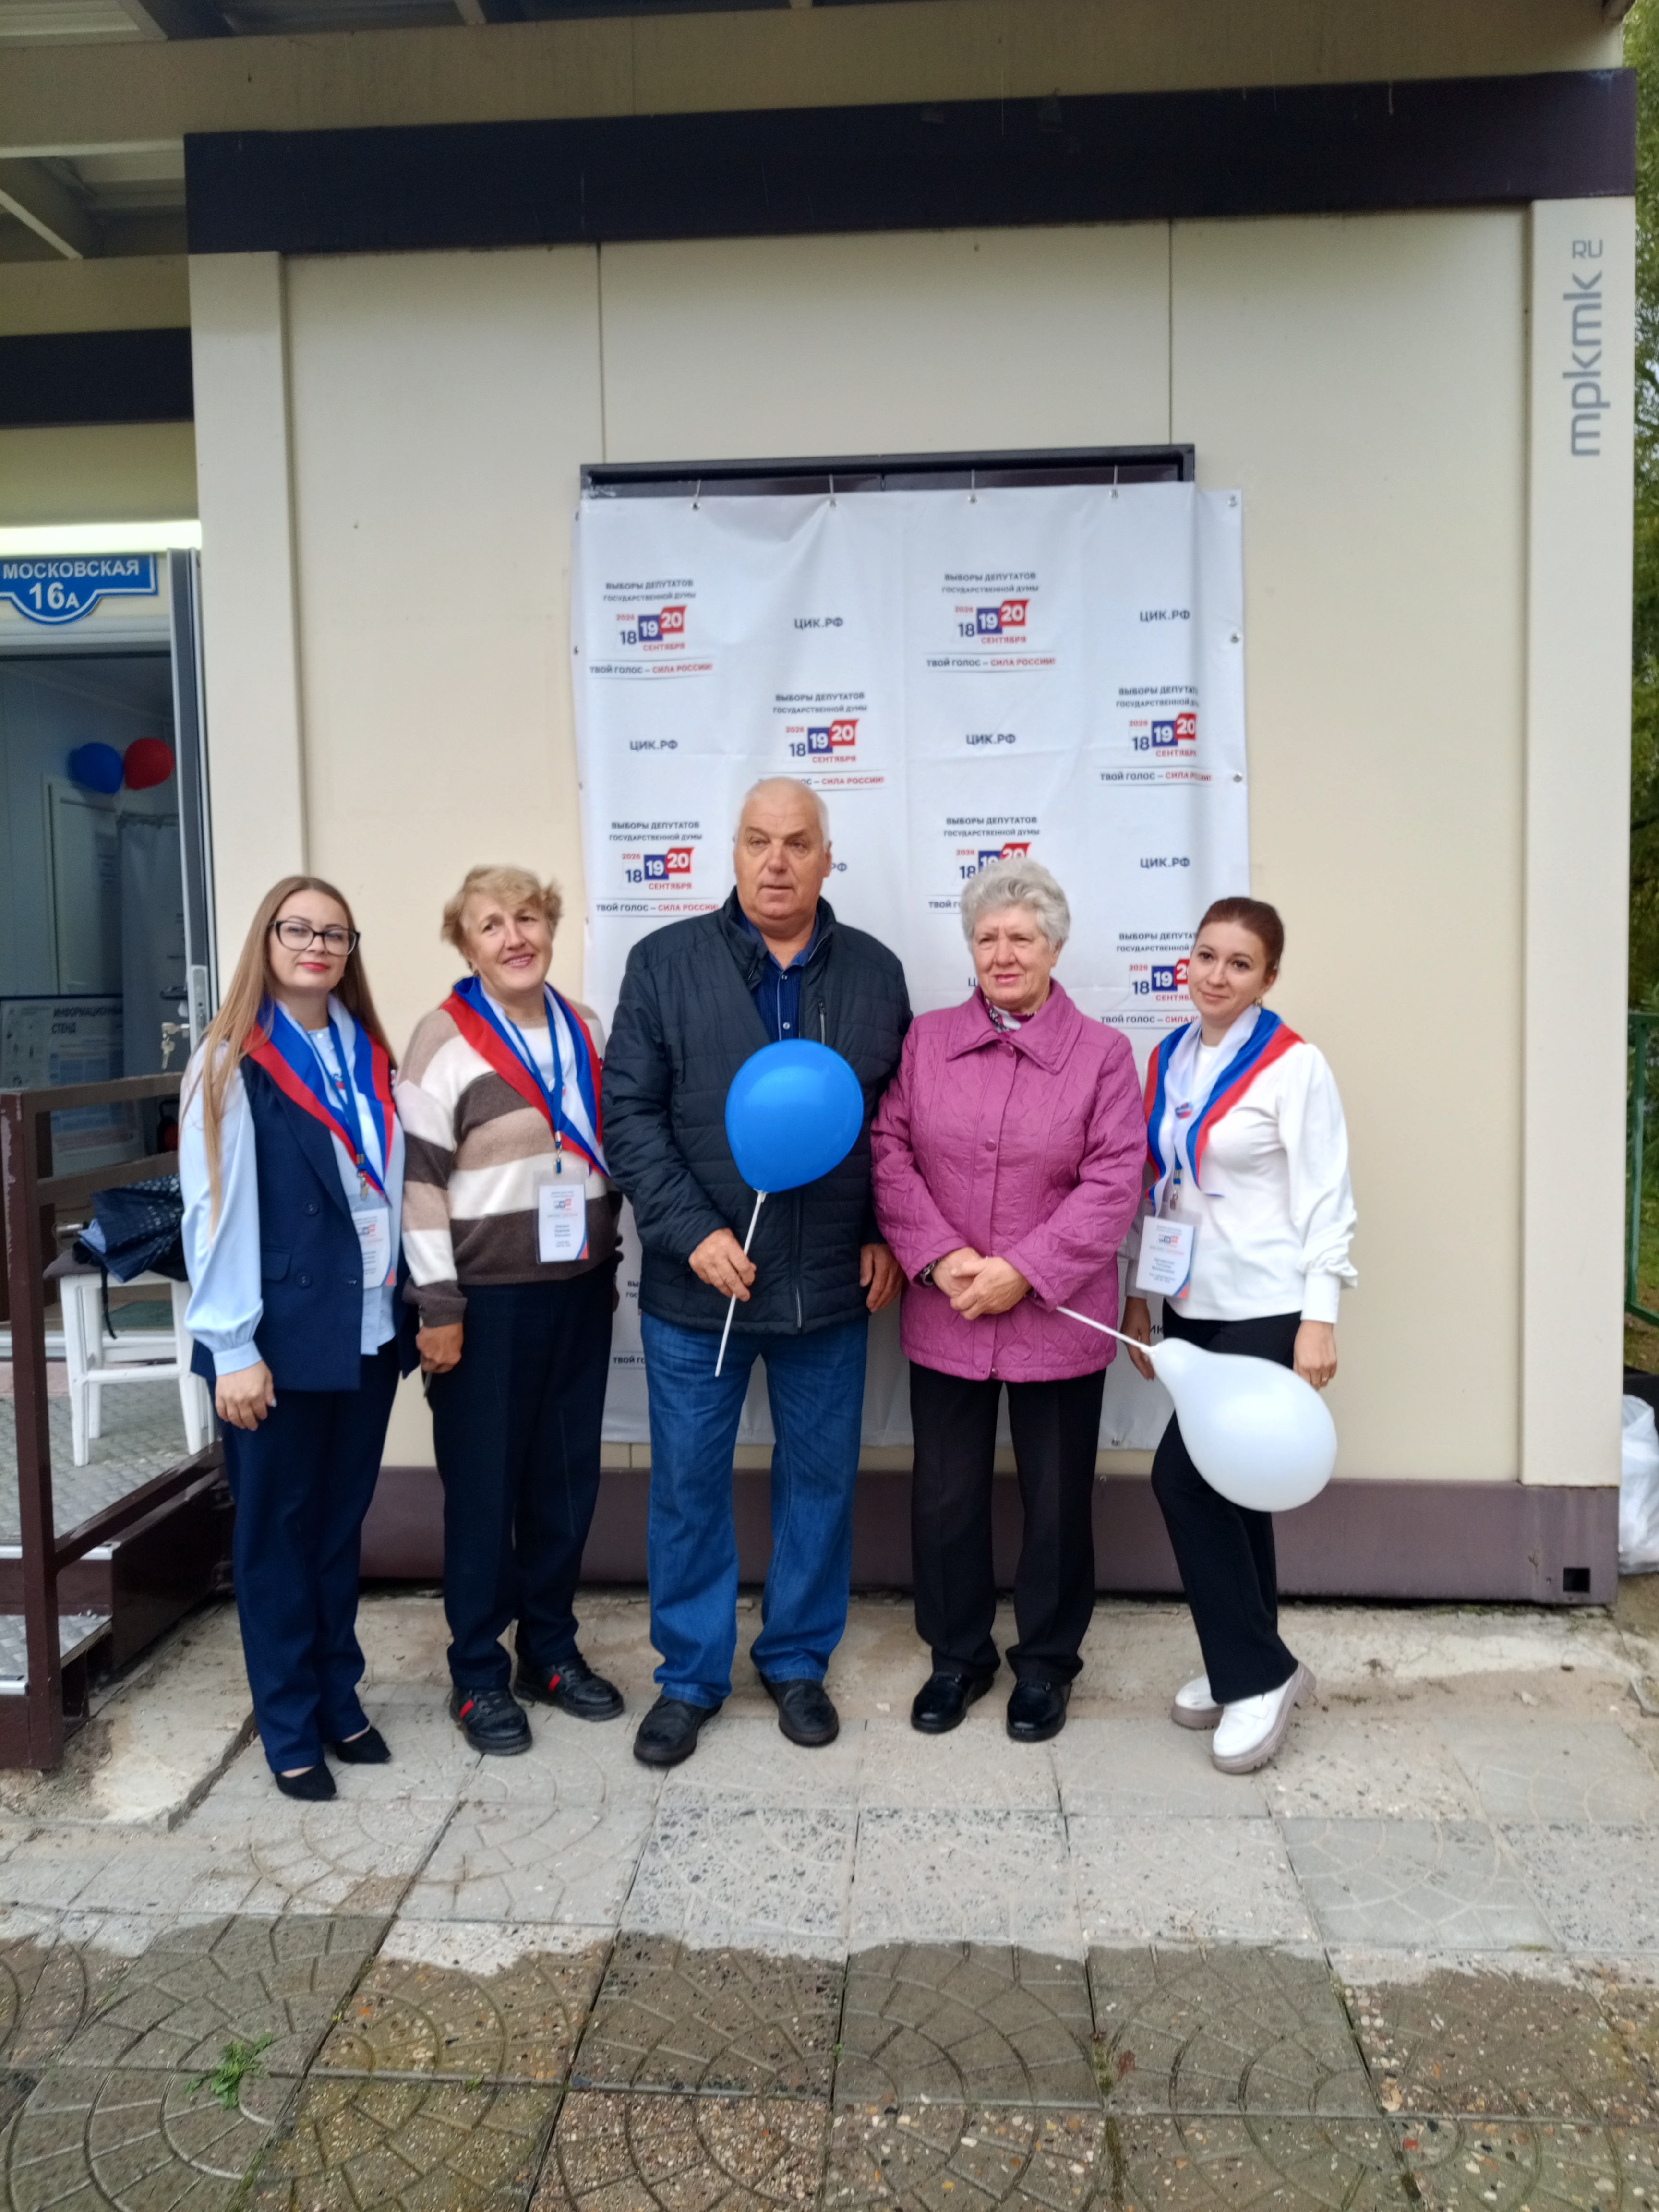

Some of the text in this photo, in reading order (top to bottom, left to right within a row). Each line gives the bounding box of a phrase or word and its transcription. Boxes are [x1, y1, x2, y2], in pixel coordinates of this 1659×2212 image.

[1563, 239, 1610, 456] mpkmk RU
[3, 559, 140, 580] МОСКОВСКАЯ
[985, 573, 1036, 582] ДЕПУТАТОВ
[645, 580, 693, 589] ДЕПУТАТОВ
[942, 585, 1014, 593] ГОСУДАРСТВЕННОЙ
[603, 593, 673, 602] ГОСУДАРСТВЕННОЙ
[958, 604, 1025, 637] 18 19 20
[1140, 609, 1190, 622] ЦИК.РФ
[620, 612, 683, 645] 18 19 20
[794, 617, 843, 630] ЦИК.РФ
[643, 643, 685, 651] СЕНТЯБРЯ
[927, 658, 950, 667] ТВОЙ
[1017, 658, 1055, 666] РОССИИ!
[590, 665, 612, 673] ТВОЙ
[1119, 687, 1157, 696] ВЫБОРЫ
[815, 692, 864, 702] ДЕПУТАТОВ
[1117, 699, 1189, 708] ГОСУДАРСТВЕННОЙ
[773, 705, 844, 714] ГОСУДАРСТВЕННОЙ
[966, 734, 1016, 745] ЦИК.РФ
[1132, 718, 1195, 751] 18 19 20
[629, 740, 678, 752] ЦИК.РФ
[790, 725, 854, 757] 18 19 20
[986, 817, 1037, 825] ДЕПУТАТОВ
[626, 853, 689, 883] 18 19 20
[1140, 857, 1190, 869] ЦИК.РФ
[960, 866, 976, 879] 18
[929, 900, 951, 908] ТВОЙ
[1132, 964, 1188, 995] 18 19 2
[1101, 1015, 1123, 1023] ТВОЙ
[613, 1355, 635, 1364] ТВОЙ
